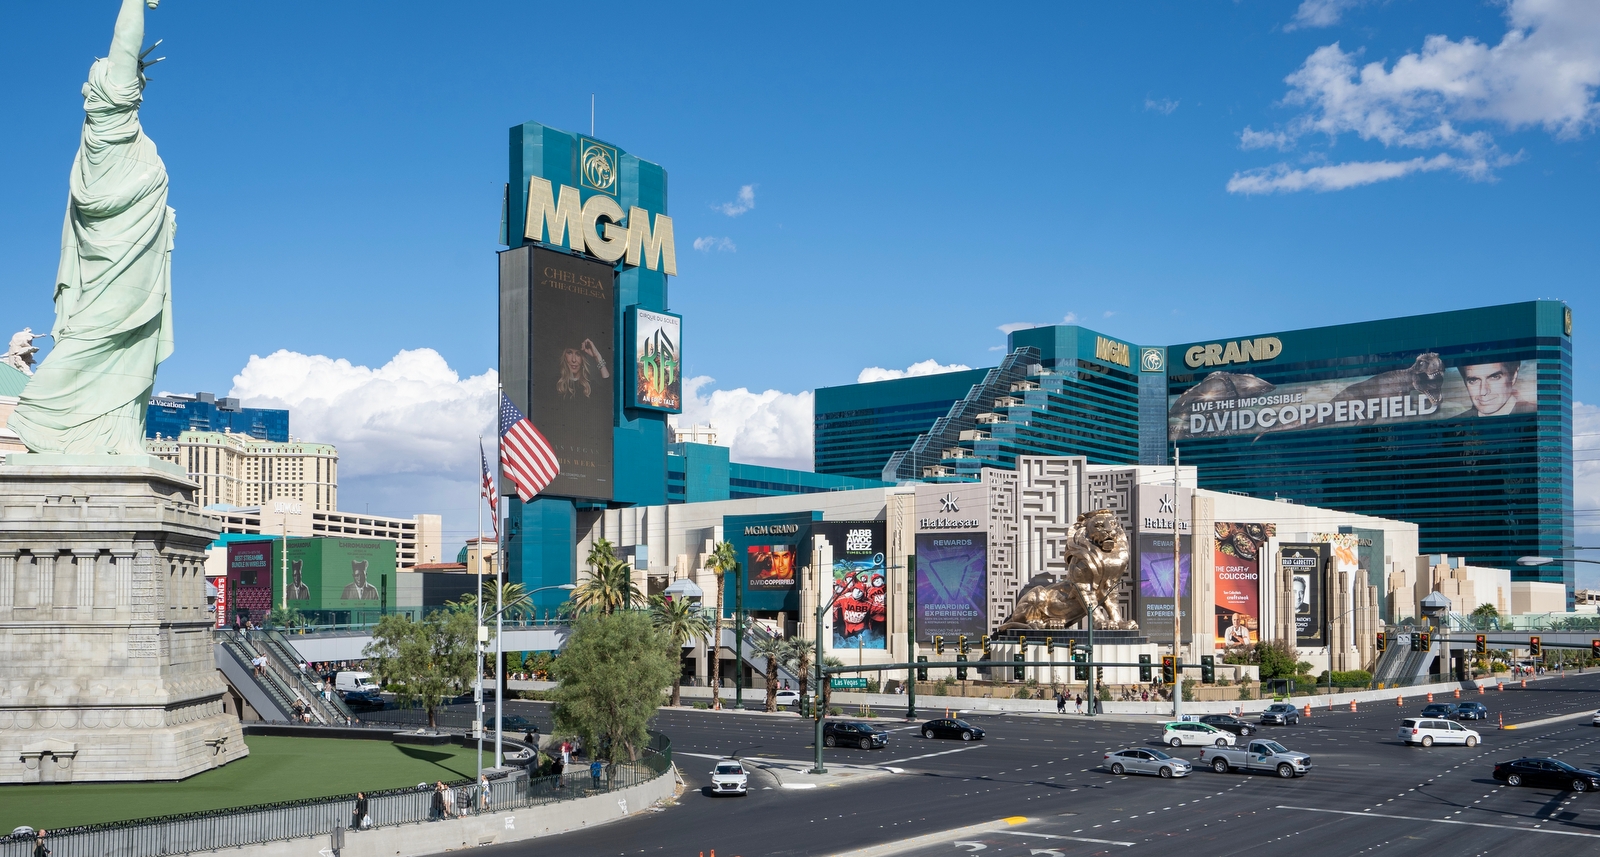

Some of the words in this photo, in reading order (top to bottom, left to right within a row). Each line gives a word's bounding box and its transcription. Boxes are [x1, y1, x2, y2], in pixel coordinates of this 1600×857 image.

[524, 175, 677, 276] MGM
[544, 266, 604, 290] CHELSEA
[549, 280, 566, 290] THE
[568, 285, 606, 300] CHELSEA
[639, 312, 656, 321] CIRQUE
[1096, 336, 1130, 368] MGM
[1184, 336, 1282, 368] GRAND
[156, 400, 186, 409] Vacations
[1192, 400, 1214, 412] LIVE
[1216, 398, 1235, 410] THE
[1238, 394, 1302, 408] IMPOSSIBLE
[574, 459, 596, 467] WEEK
[920, 517, 979, 528] Hakkasan
[744, 526, 768, 535] MGM
[770, 524, 798, 534] GRAND
[846, 529, 872, 537] JABB
[846, 536, 872, 544] AWOC
[843, 679, 858, 687] Vegas
